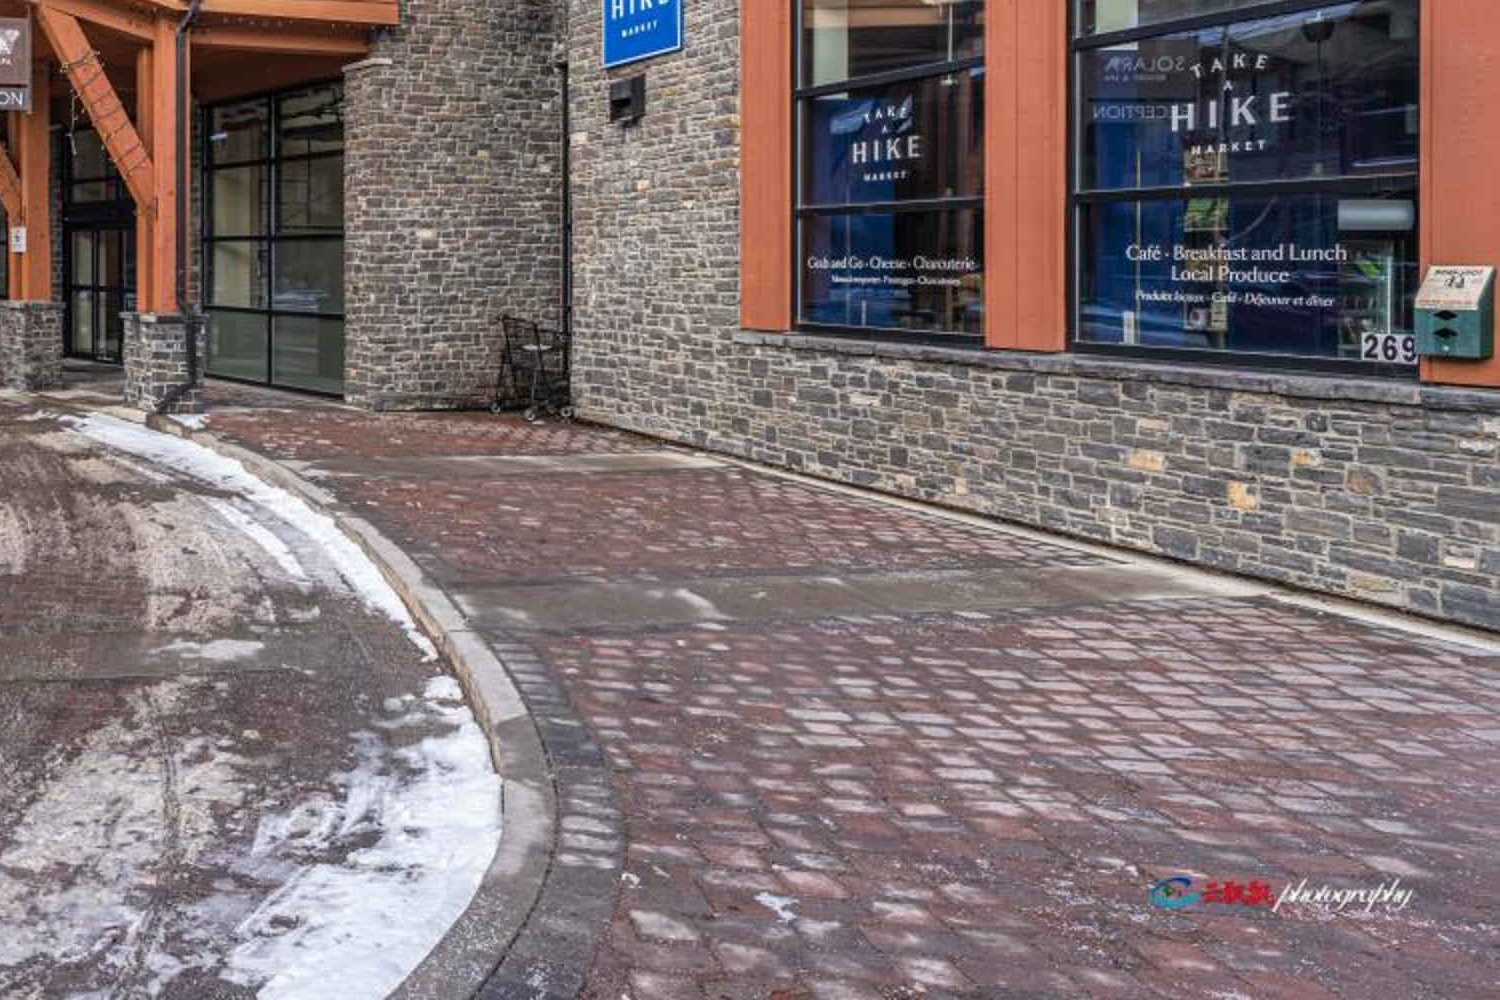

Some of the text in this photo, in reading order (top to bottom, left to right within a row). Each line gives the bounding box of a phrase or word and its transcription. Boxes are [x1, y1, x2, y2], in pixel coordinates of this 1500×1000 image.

[1190, 53, 1269, 78] TAKE
[1223, 80, 1233, 91] A
[864, 105, 908, 124] TAKE
[1171, 92, 1290, 132] HIKE
[881, 124, 889, 134] A
[852, 135, 922, 164] HIKE
[1191, 140, 1266, 154] MARKET
[863, 170, 906, 182] MARKET
[1125, 243, 1347, 261] Café Breakfast and Lunch
[870, 255, 907, 269] Cheese
[1171, 265, 1290, 283] Local Produce
[1363, 334, 1416, 361] 269
